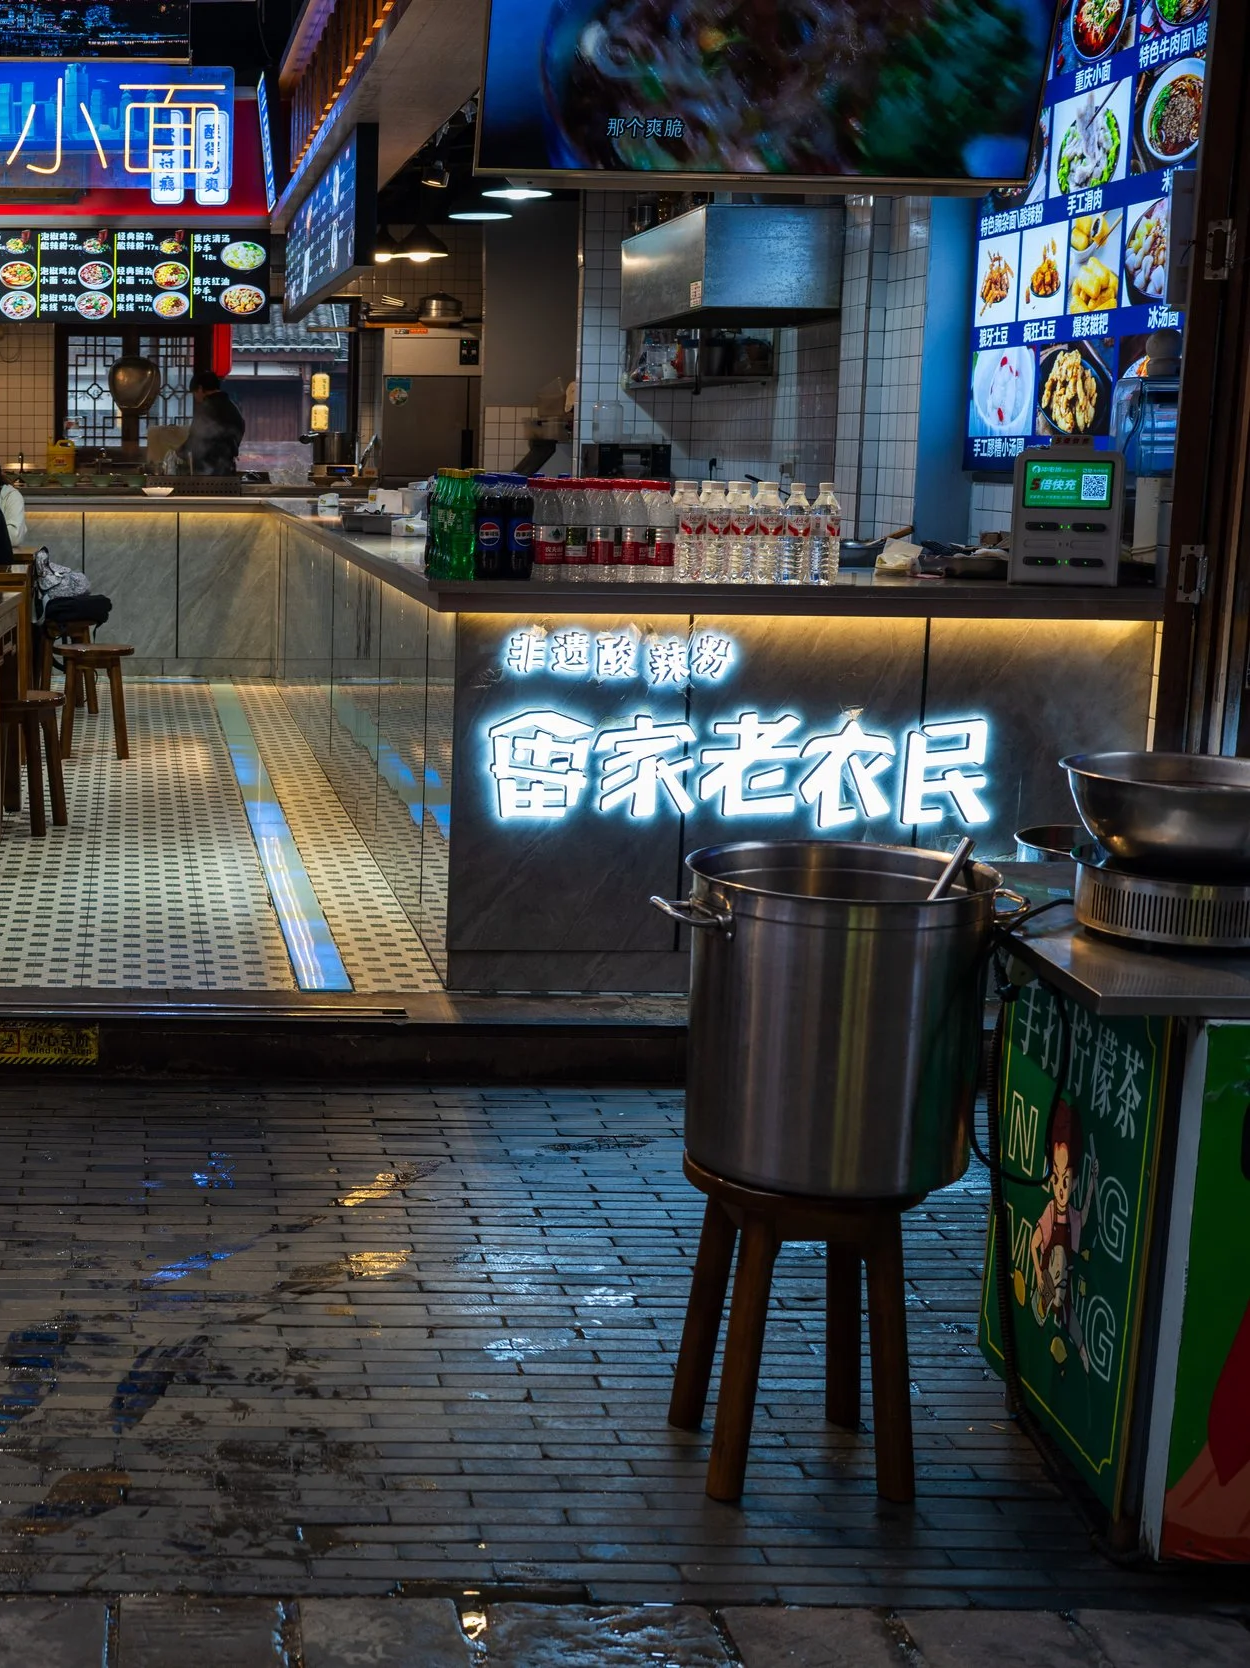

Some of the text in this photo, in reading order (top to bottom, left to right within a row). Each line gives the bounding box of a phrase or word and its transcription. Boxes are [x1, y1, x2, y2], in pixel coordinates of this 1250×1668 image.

[1075, 60, 1112, 93] 重庆小面
[606, 117, 685, 138] 那个爽脆
[1067, 189, 1103, 216] 手工滑肉
[40, 276, 58, 284] 小面
[117, 276, 135, 284] 小面
[1072, 313, 1109, 338] 爆浆糍粑
[1147, 306, 1179, 329] 冰汤圆
[979, 327, 1009, 348] 狼牙土豆
[1023, 320, 1056, 343] 疯狂土豆
[1030, 478, 1077, 491] 5倍快充
[507, 633, 735, 685] 非遗酸辣粉
[1017, 978, 1145, 1140] 手打柠檬茶
